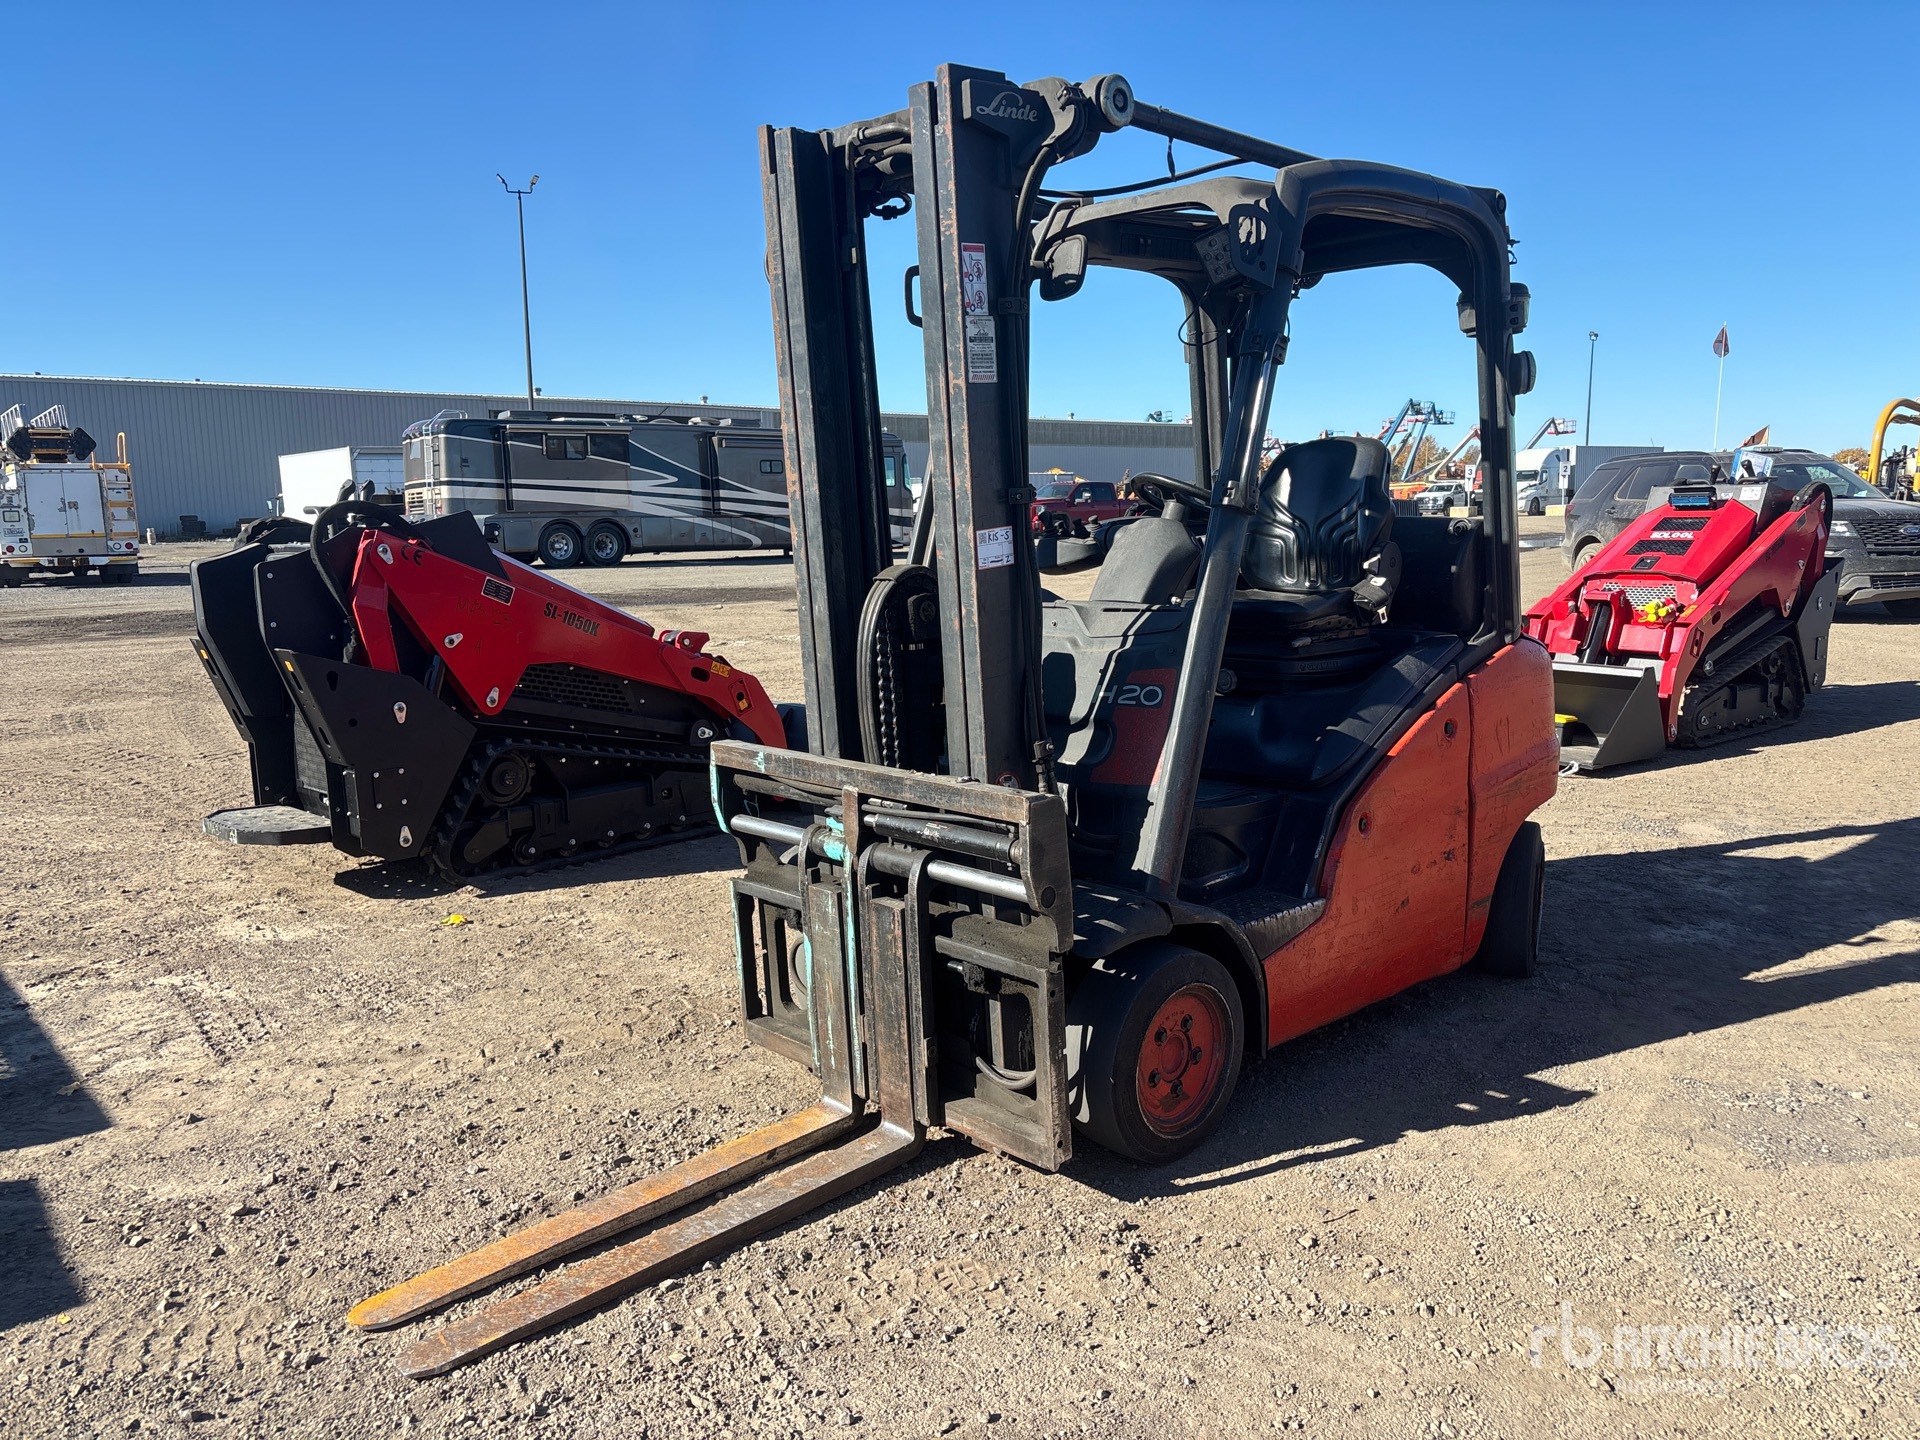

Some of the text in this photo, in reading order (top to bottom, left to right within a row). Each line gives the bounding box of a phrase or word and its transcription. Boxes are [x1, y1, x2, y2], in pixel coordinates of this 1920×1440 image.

[976, 91, 1038, 122] Linde
[543, 602, 601, 637] SL-1050K
[1092, 683, 1163, 706] H20
